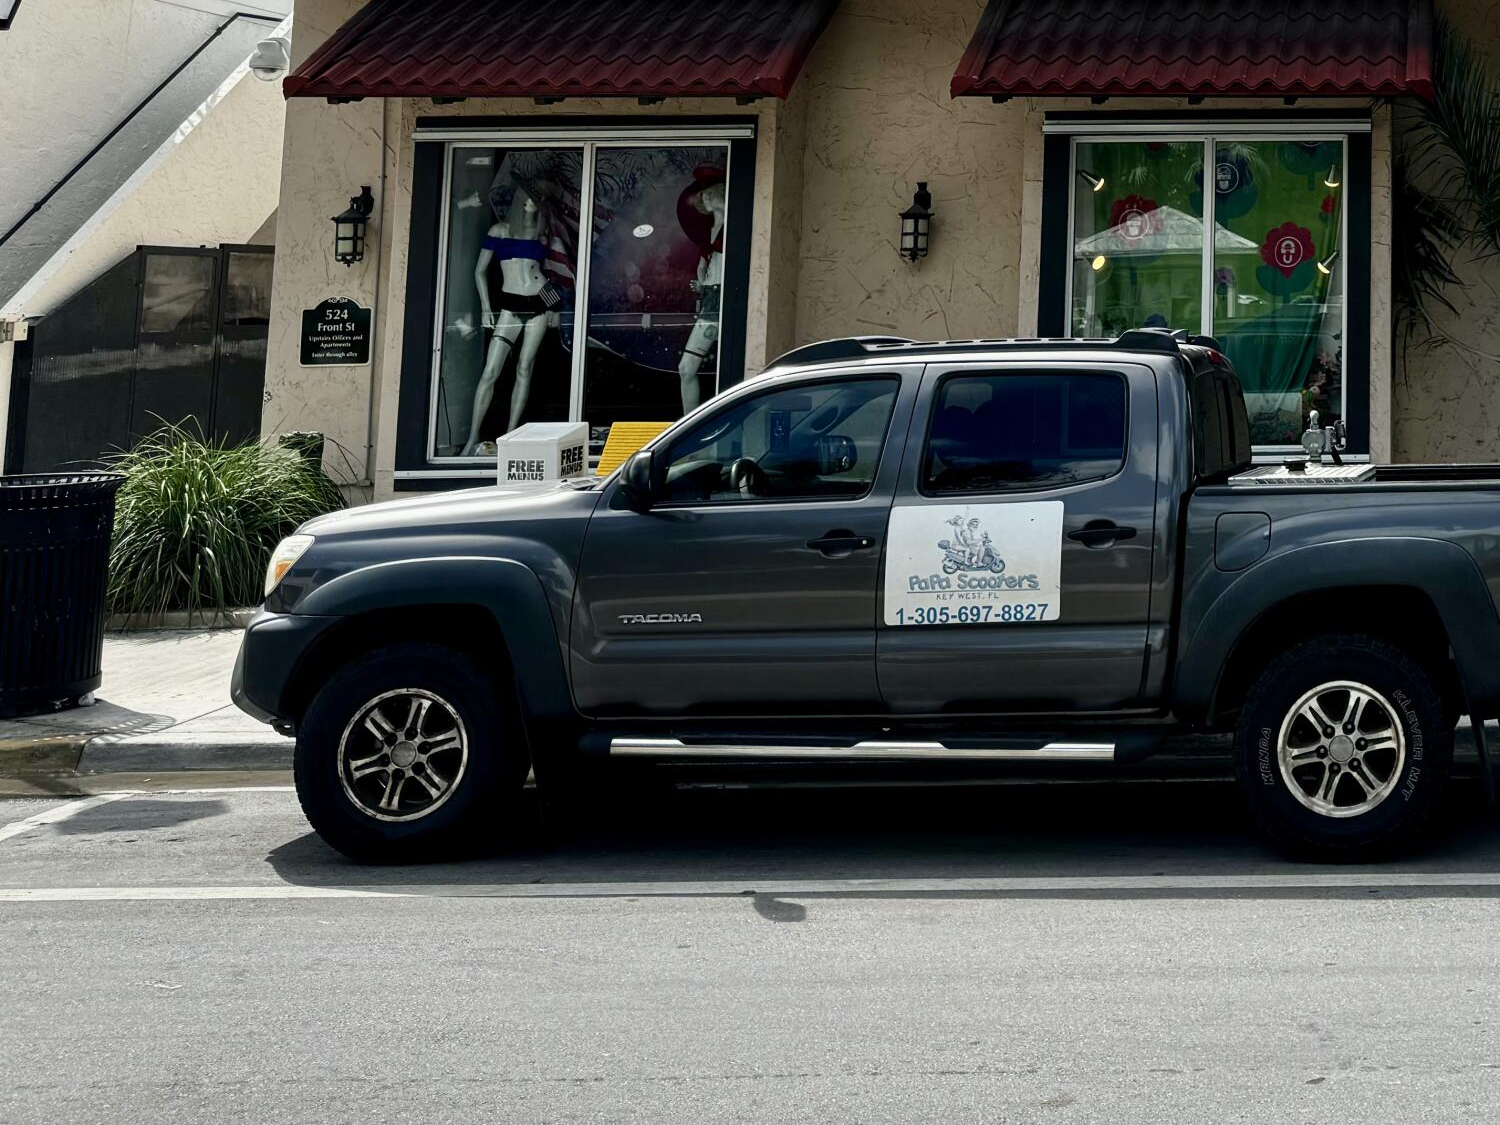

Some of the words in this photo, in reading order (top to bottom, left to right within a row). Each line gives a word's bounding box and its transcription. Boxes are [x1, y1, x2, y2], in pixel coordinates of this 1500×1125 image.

[325, 308, 349, 320] 524
[317, 322, 343, 332] Front
[345, 322, 355, 332] St
[560, 445, 584, 466] FREE
[507, 460, 545, 473] FREE
[560, 461, 583, 477] MENUS
[507, 472, 544, 481] MENUS
[957, 573, 1040, 589] Scooters
[936, 592, 954, 600] KEY
[988, 591, 999, 599] FL
[617, 613, 702, 624] TACOMA
[896, 603, 1049, 625] 1-305-697-8827
[1392, 689, 1423, 761] KLEVER
[1258, 726, 1274, 786] KENDA
[1401, 766, 1421, 801] M/T
